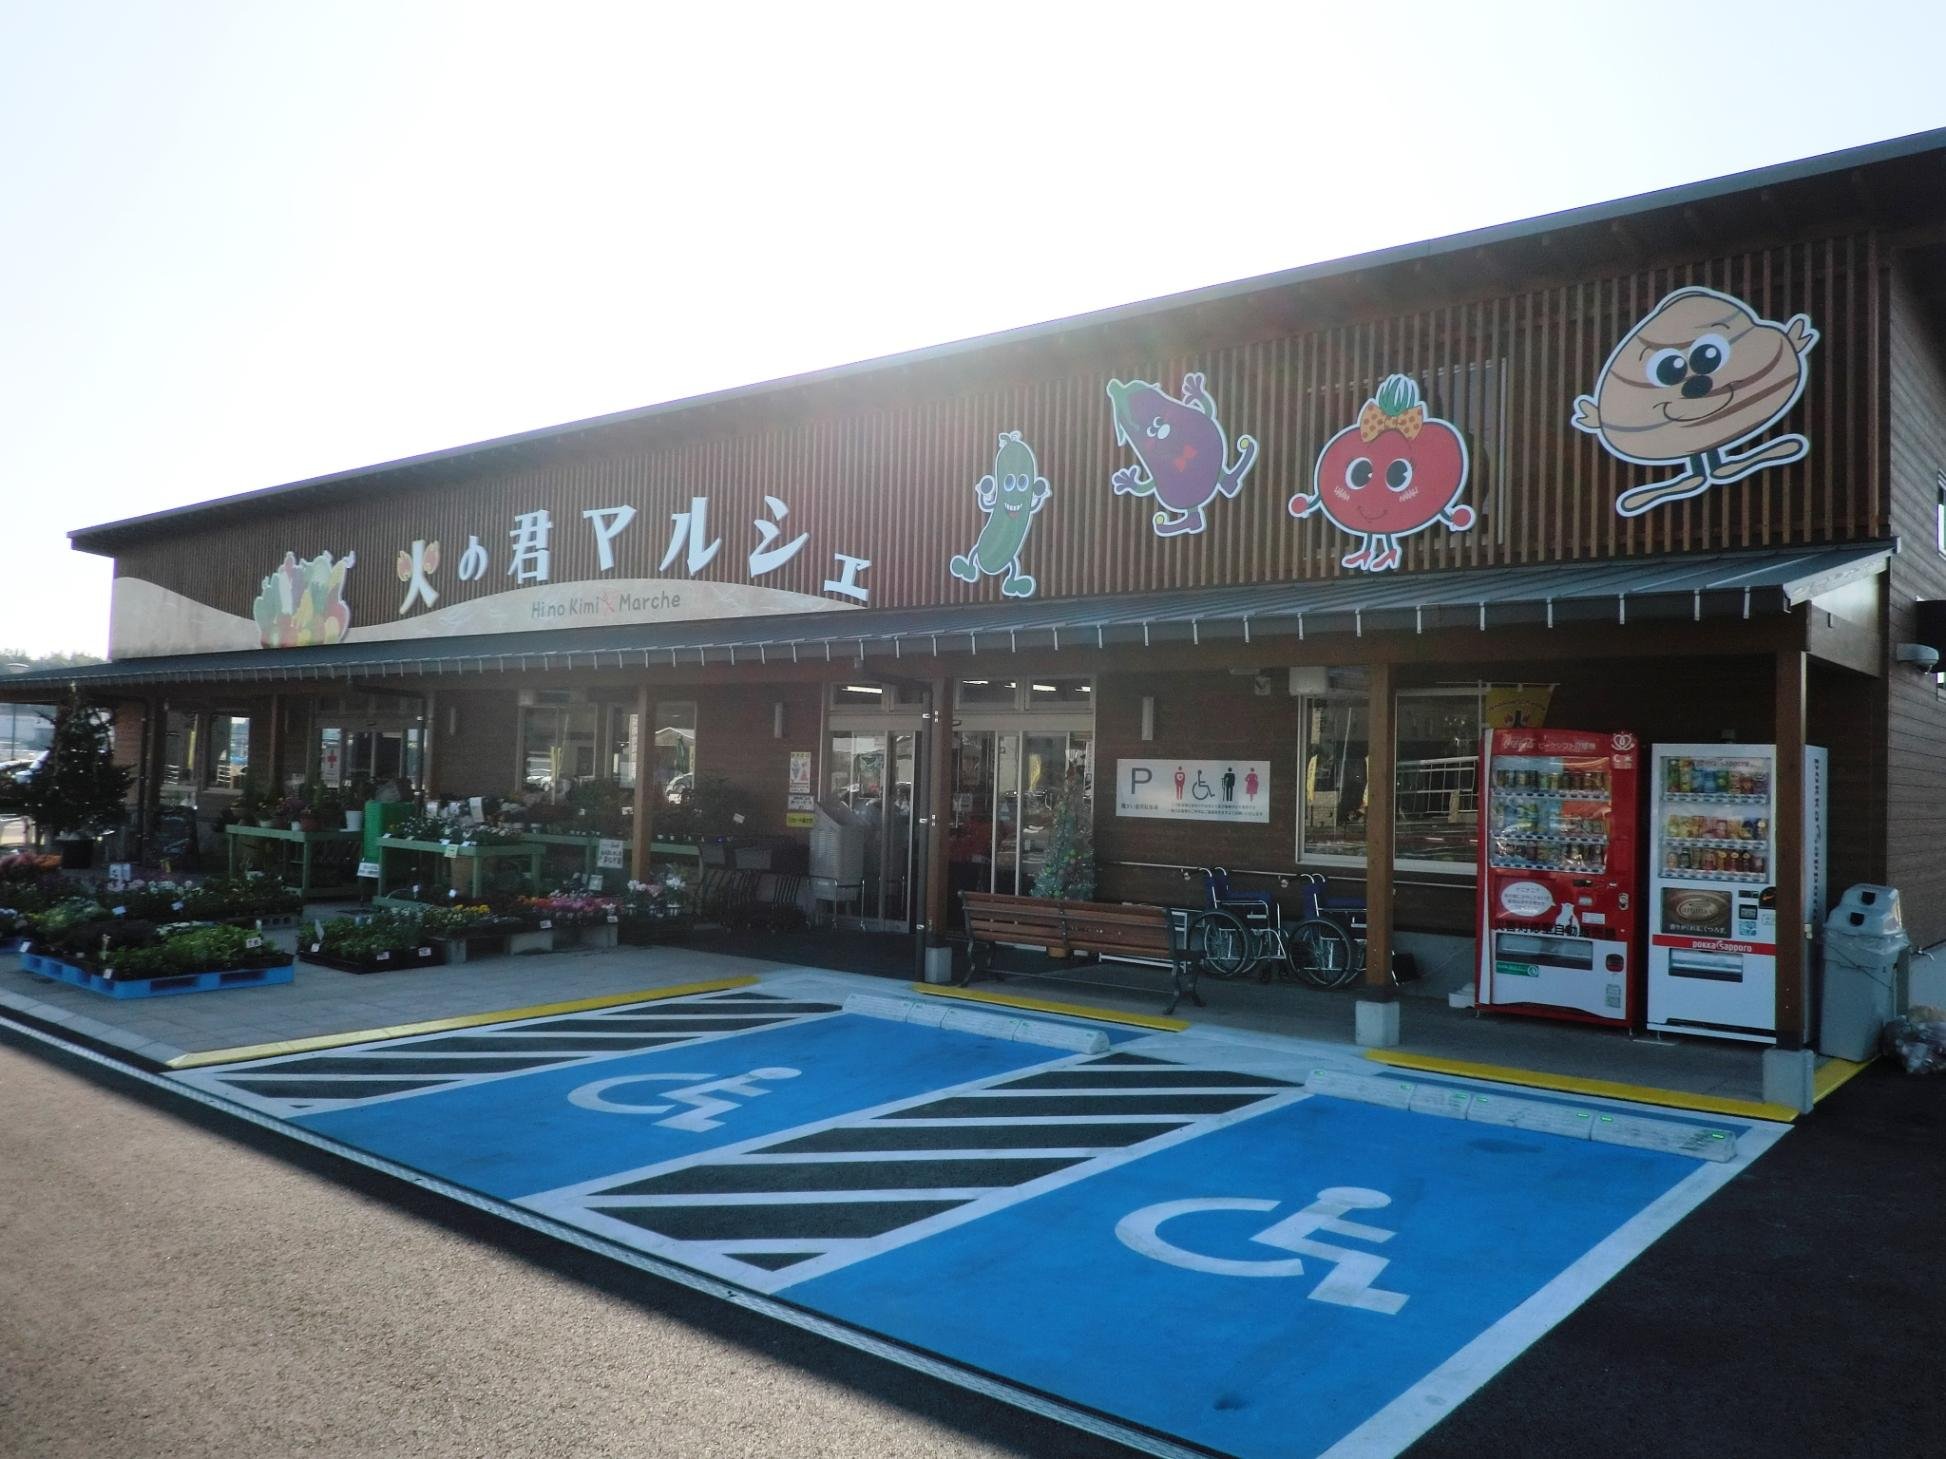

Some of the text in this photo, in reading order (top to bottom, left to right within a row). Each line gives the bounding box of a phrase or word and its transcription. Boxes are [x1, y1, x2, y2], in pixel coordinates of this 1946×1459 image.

[398, 495, 872, 614] 火の君マルシェ
[530, 590, 681, 619] Hino Kimi Marche
[1130, 767, 1153, 795] P
